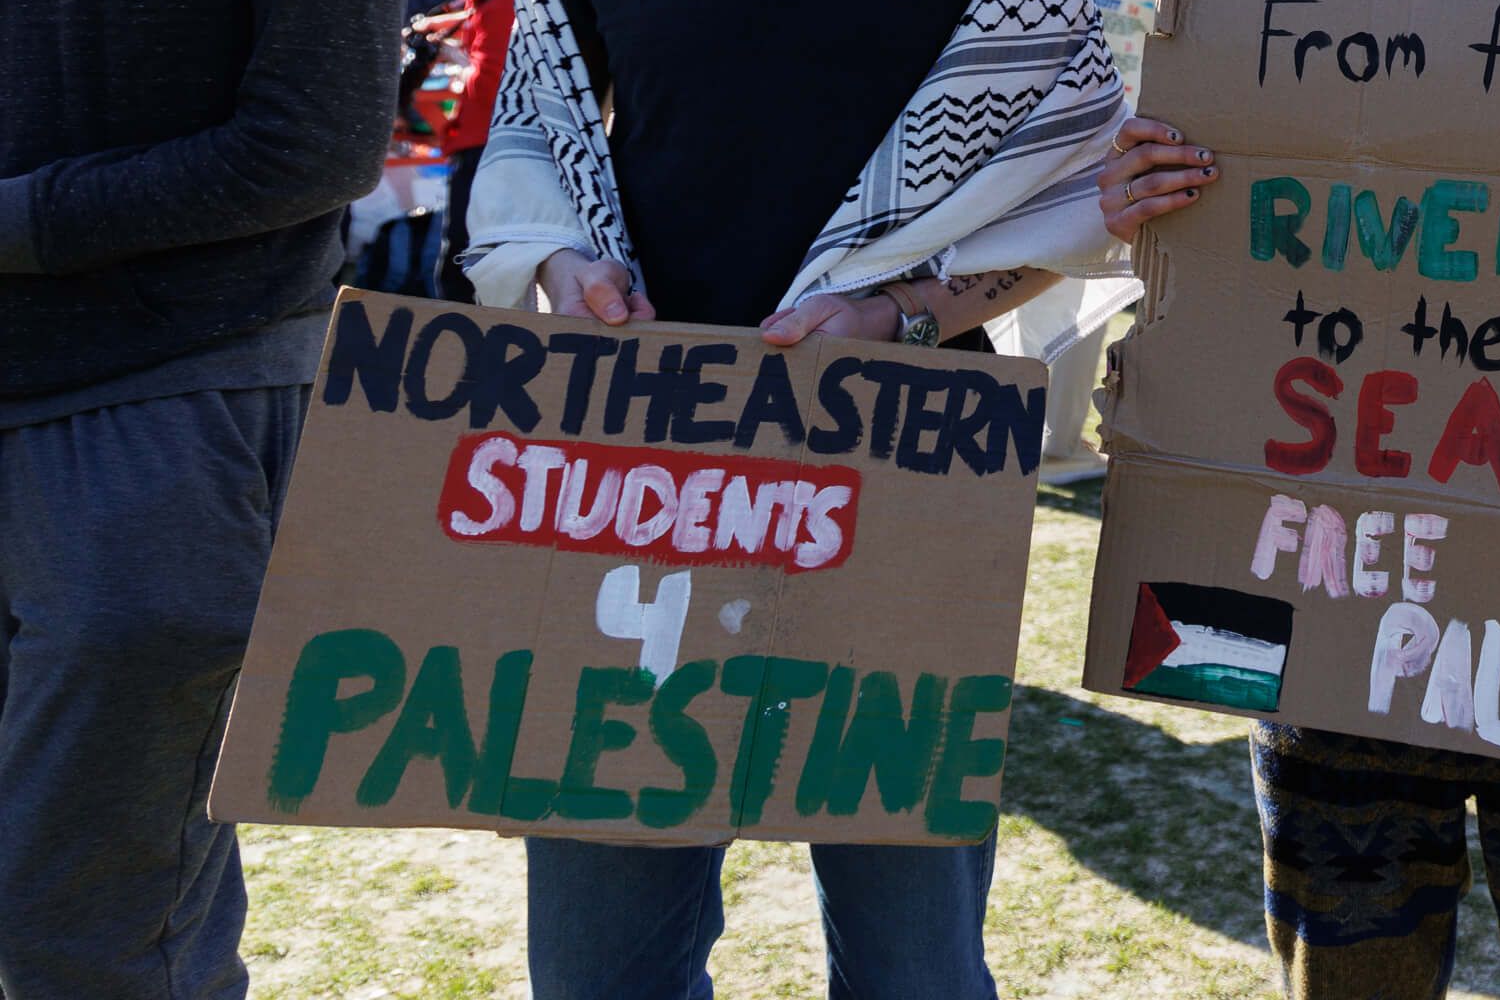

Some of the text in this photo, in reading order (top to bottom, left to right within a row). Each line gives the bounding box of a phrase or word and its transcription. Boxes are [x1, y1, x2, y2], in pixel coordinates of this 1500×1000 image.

[322, 300, 1046, 476] NORTHEASTERN
[1284, 290, 1364, 364] to
[449, 437, 852, 569] STUDENTS
[1250, 494, 1449, 602] FREE
[596, 564, 691, 687] 4
[267, 628, 1013, 837] PALESTINE
